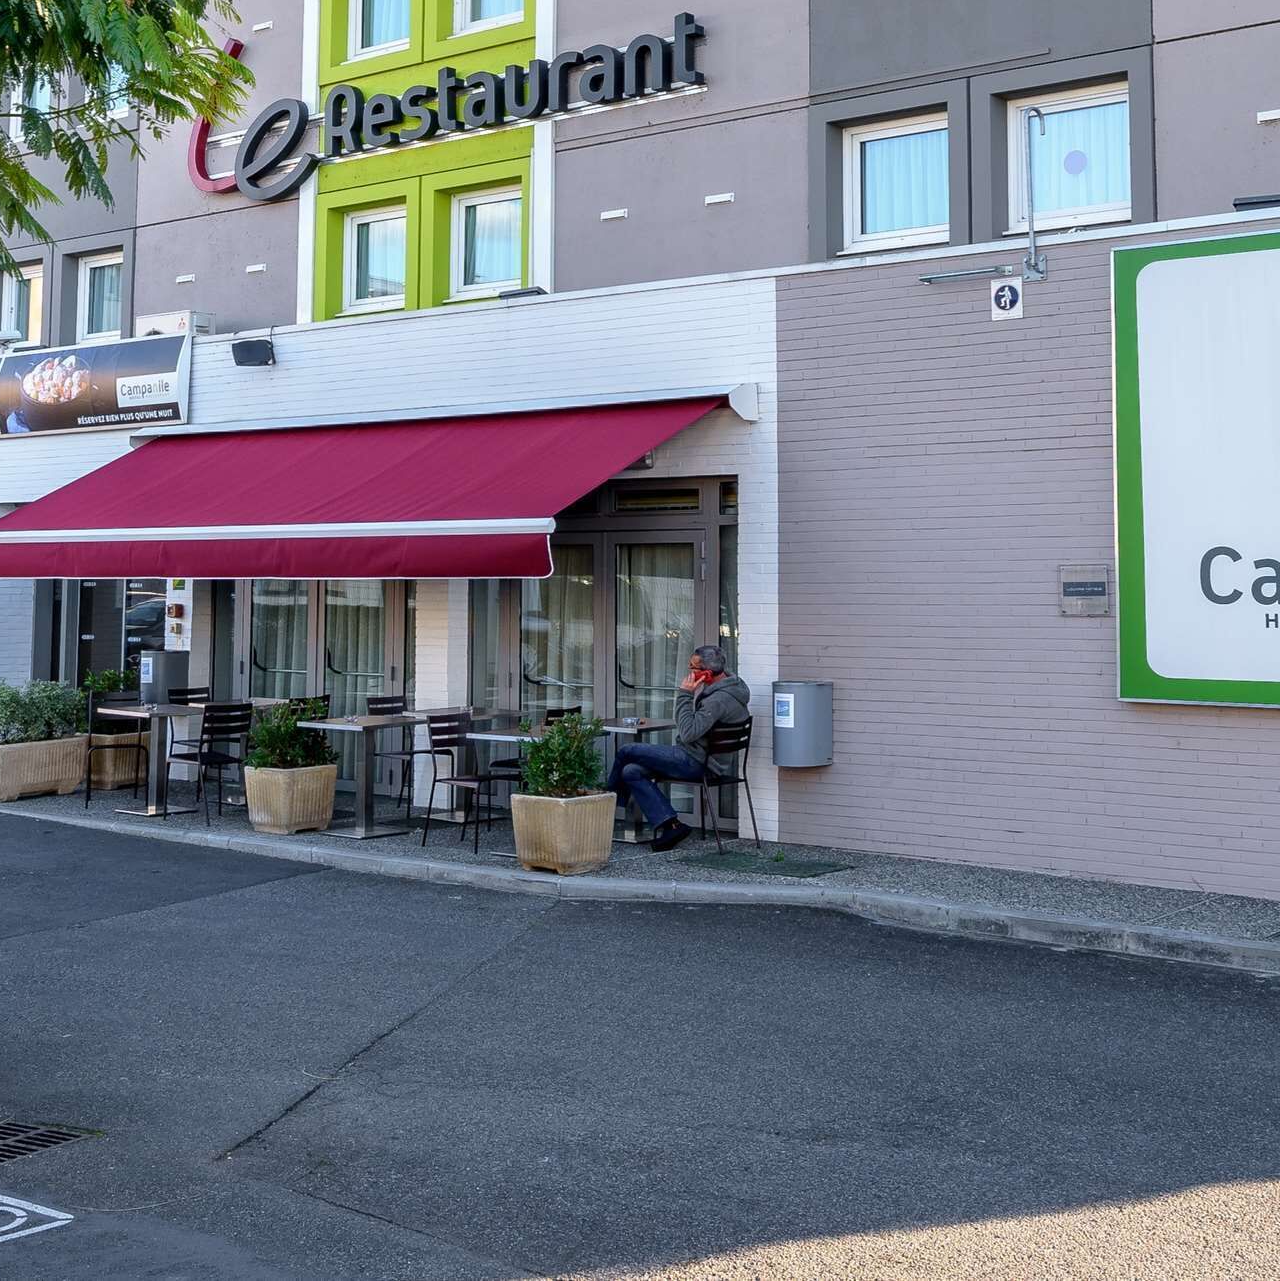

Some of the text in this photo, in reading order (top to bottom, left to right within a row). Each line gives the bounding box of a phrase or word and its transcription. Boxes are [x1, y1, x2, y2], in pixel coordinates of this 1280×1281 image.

[323, 12, 705, 157] Restaurant
[120, 380, 170, 398] Campanile
[78, 416, 105, 425] RÉSERVEZ
[120, 413, 134, 421] PLUS
[135, 411, 157, 421] QU'UNE
[158, 409, 173, 417] NUIT
